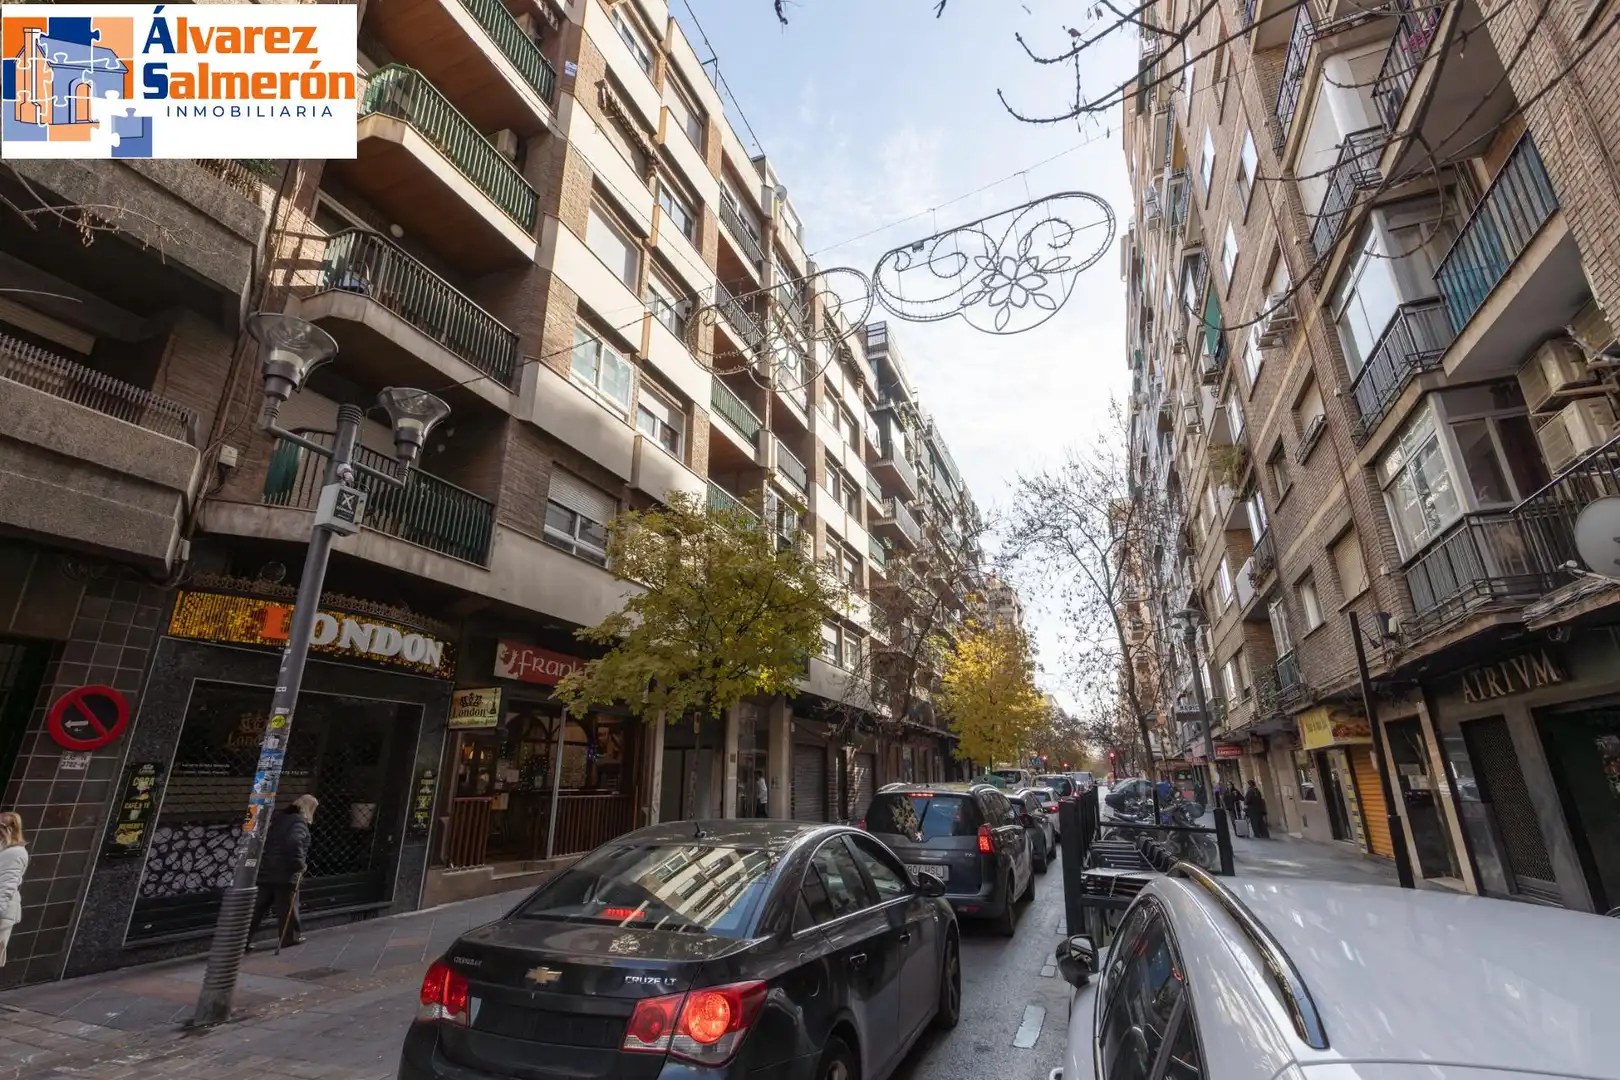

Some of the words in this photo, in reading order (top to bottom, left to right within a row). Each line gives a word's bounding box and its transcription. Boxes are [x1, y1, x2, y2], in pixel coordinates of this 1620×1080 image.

[262, 606, 444, 669] LONDON
[1461, 647, 1562, 704] ATRIVM
[451, 706, 486, 719] London
[624, 975, 661, 985] CRUZE
[664, 977, 677, 986] LT
